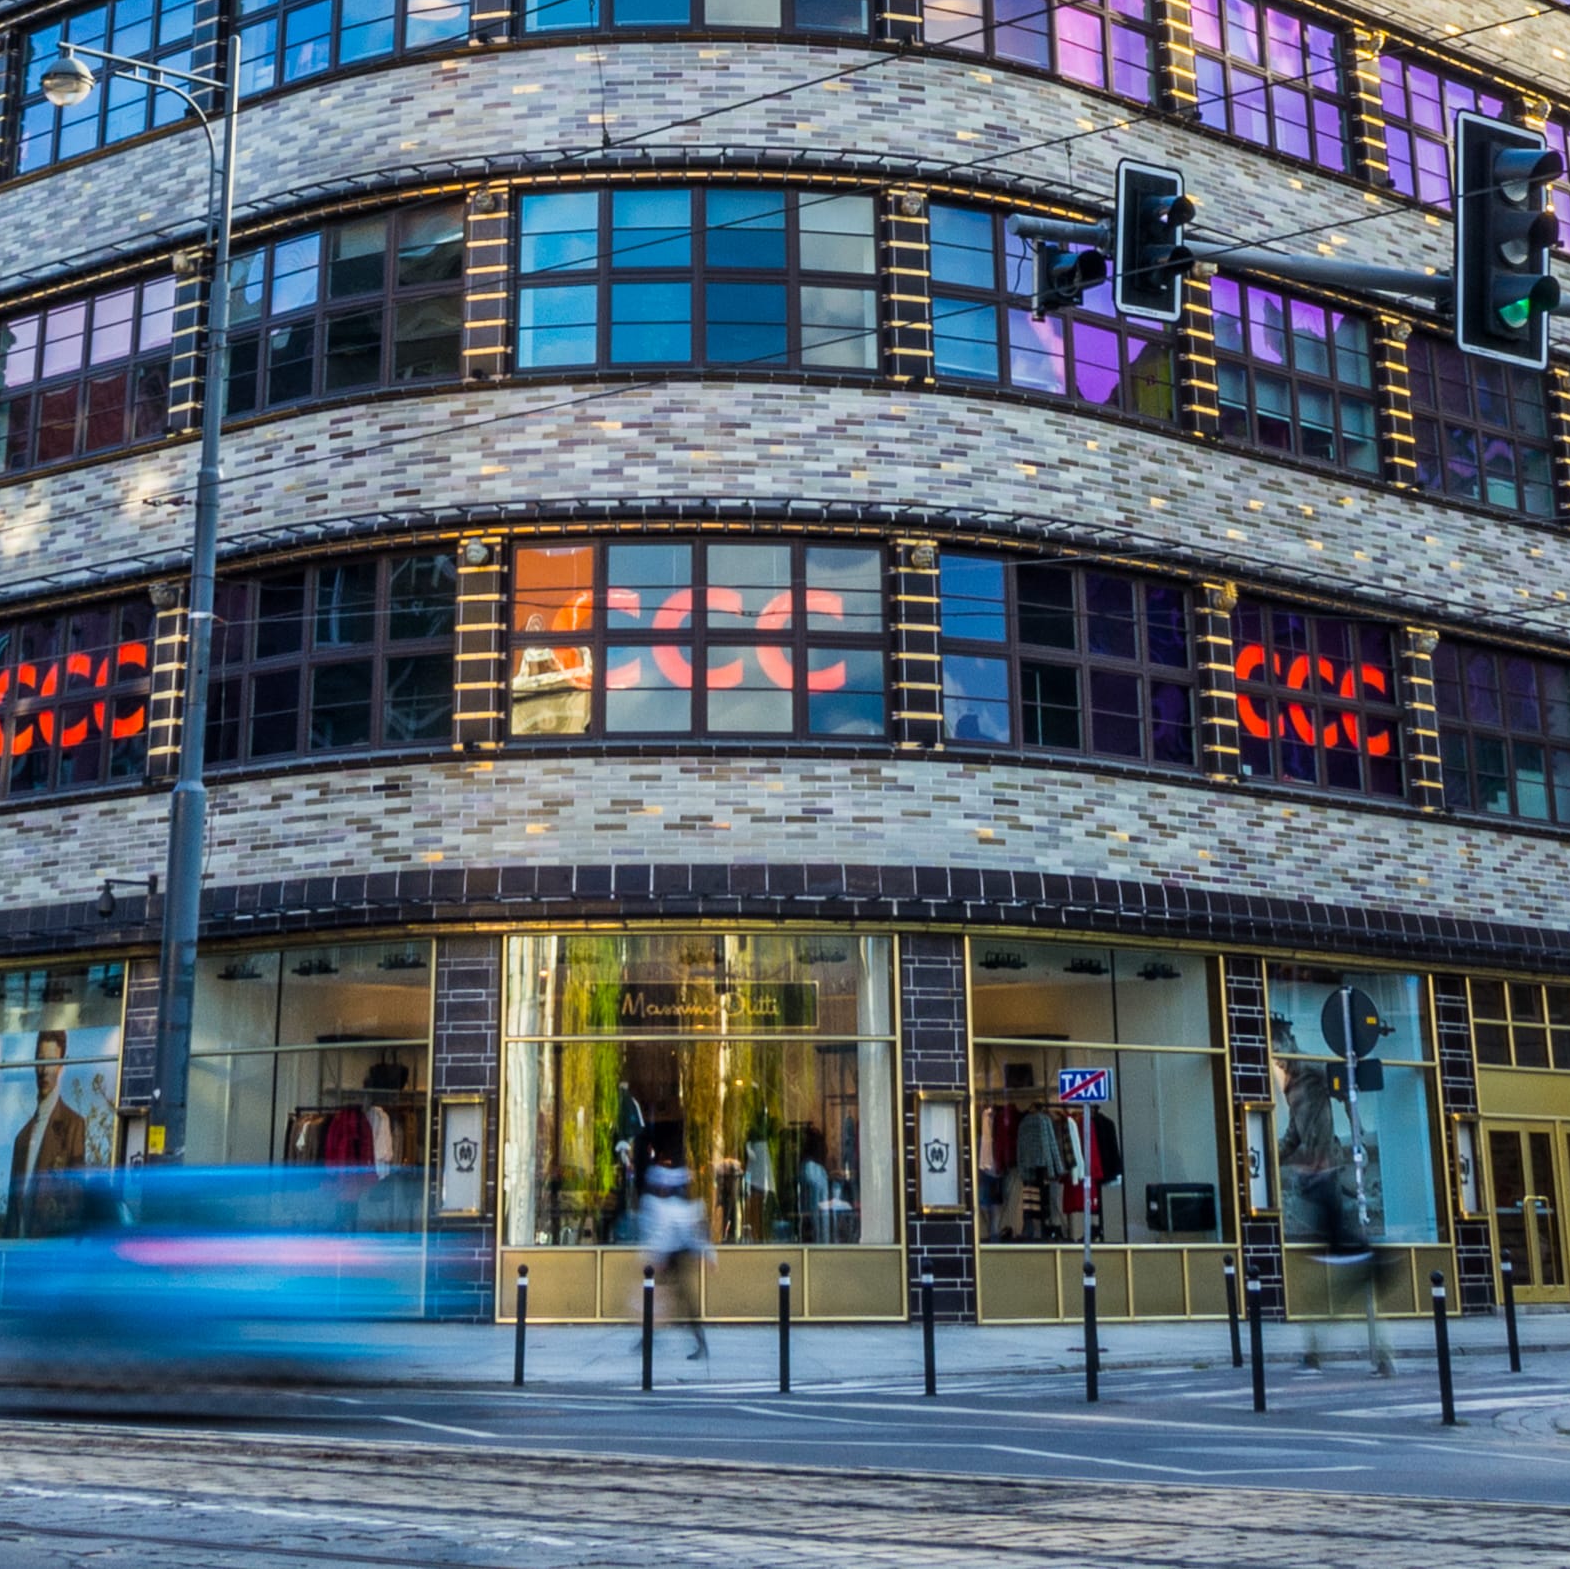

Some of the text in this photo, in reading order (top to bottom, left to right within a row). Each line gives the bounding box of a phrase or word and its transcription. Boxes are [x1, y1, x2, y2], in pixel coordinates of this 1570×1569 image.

[552, 587, 847, 693] CCC
[1235, 642, 1391, 758] CCC
[1060, 1072, 1106, 1098] TAXI
